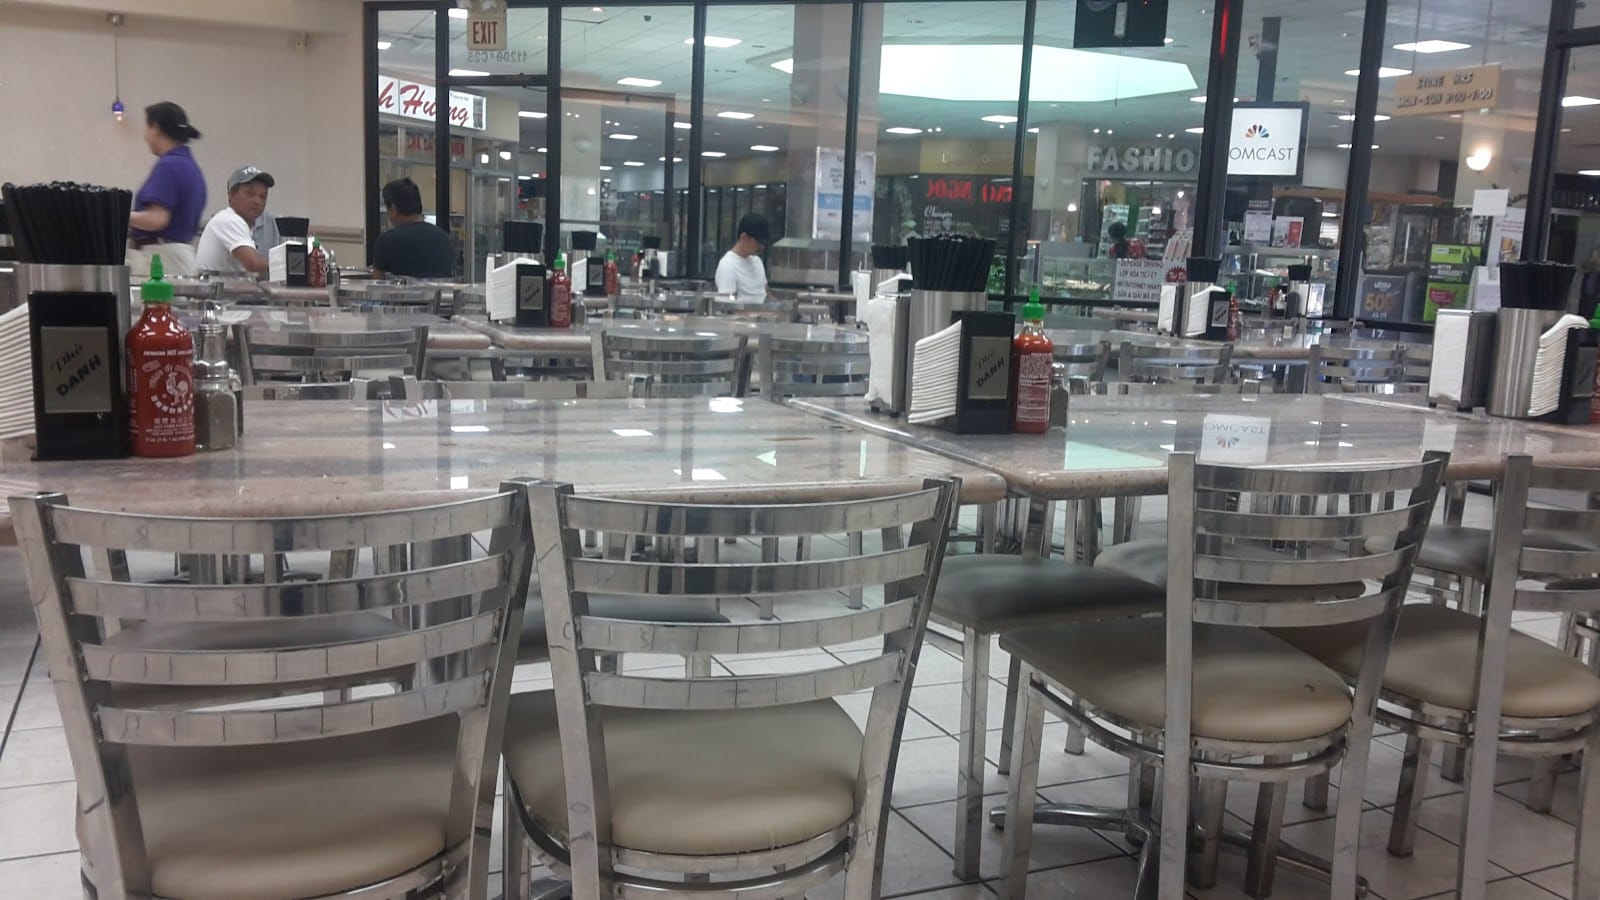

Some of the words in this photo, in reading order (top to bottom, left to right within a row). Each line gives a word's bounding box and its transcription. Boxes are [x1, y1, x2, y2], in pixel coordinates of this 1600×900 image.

[473, 21, 497, 45] EXIT
[1087, 146, 1195, 172] FASHIO
[1229, 147, 1294, 161] OMCAST
[56, 354, 100, 397] DANH
[976, 355, 1005, 387] DANH
